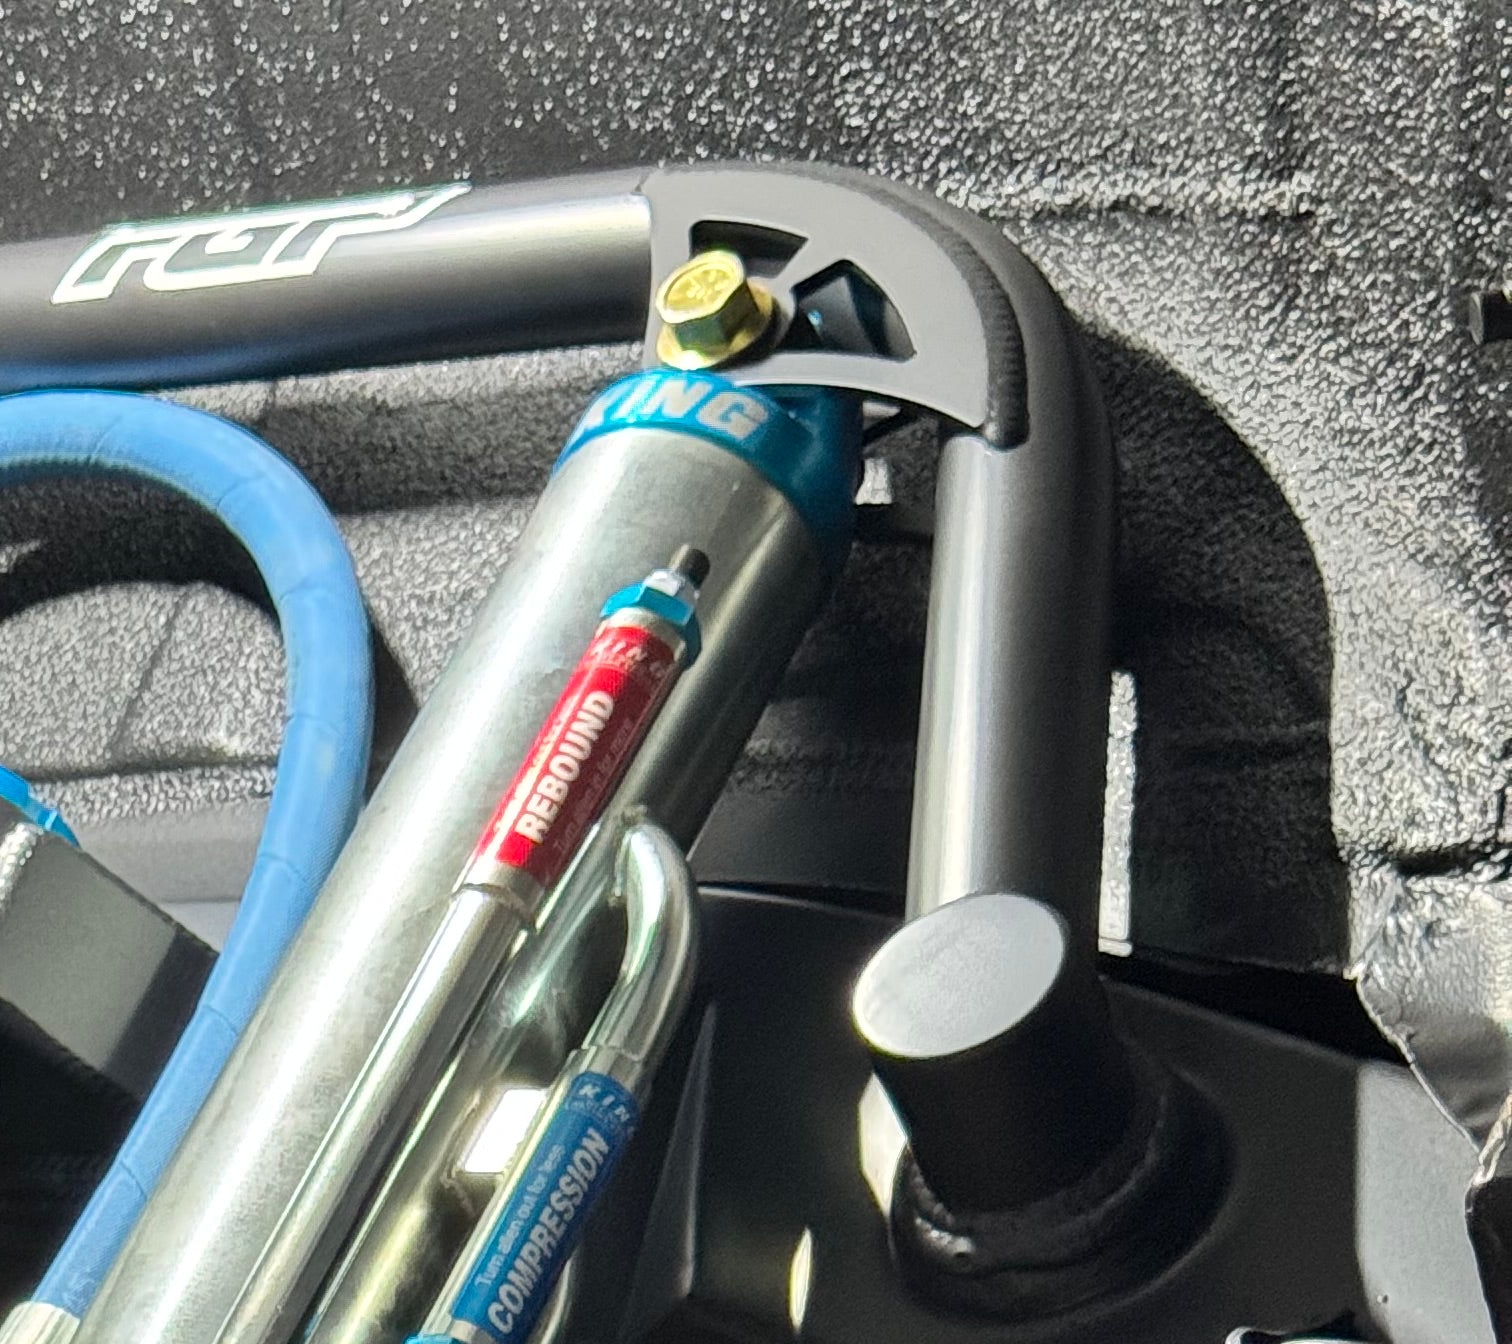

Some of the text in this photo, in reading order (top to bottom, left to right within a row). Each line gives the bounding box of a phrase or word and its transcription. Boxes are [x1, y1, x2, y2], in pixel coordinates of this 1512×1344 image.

[515, 690, 614, 843] REBOUND
[475, 1254, 505, 1286] Turn
[488, 1127, 610, 1334] COMPRESSION
